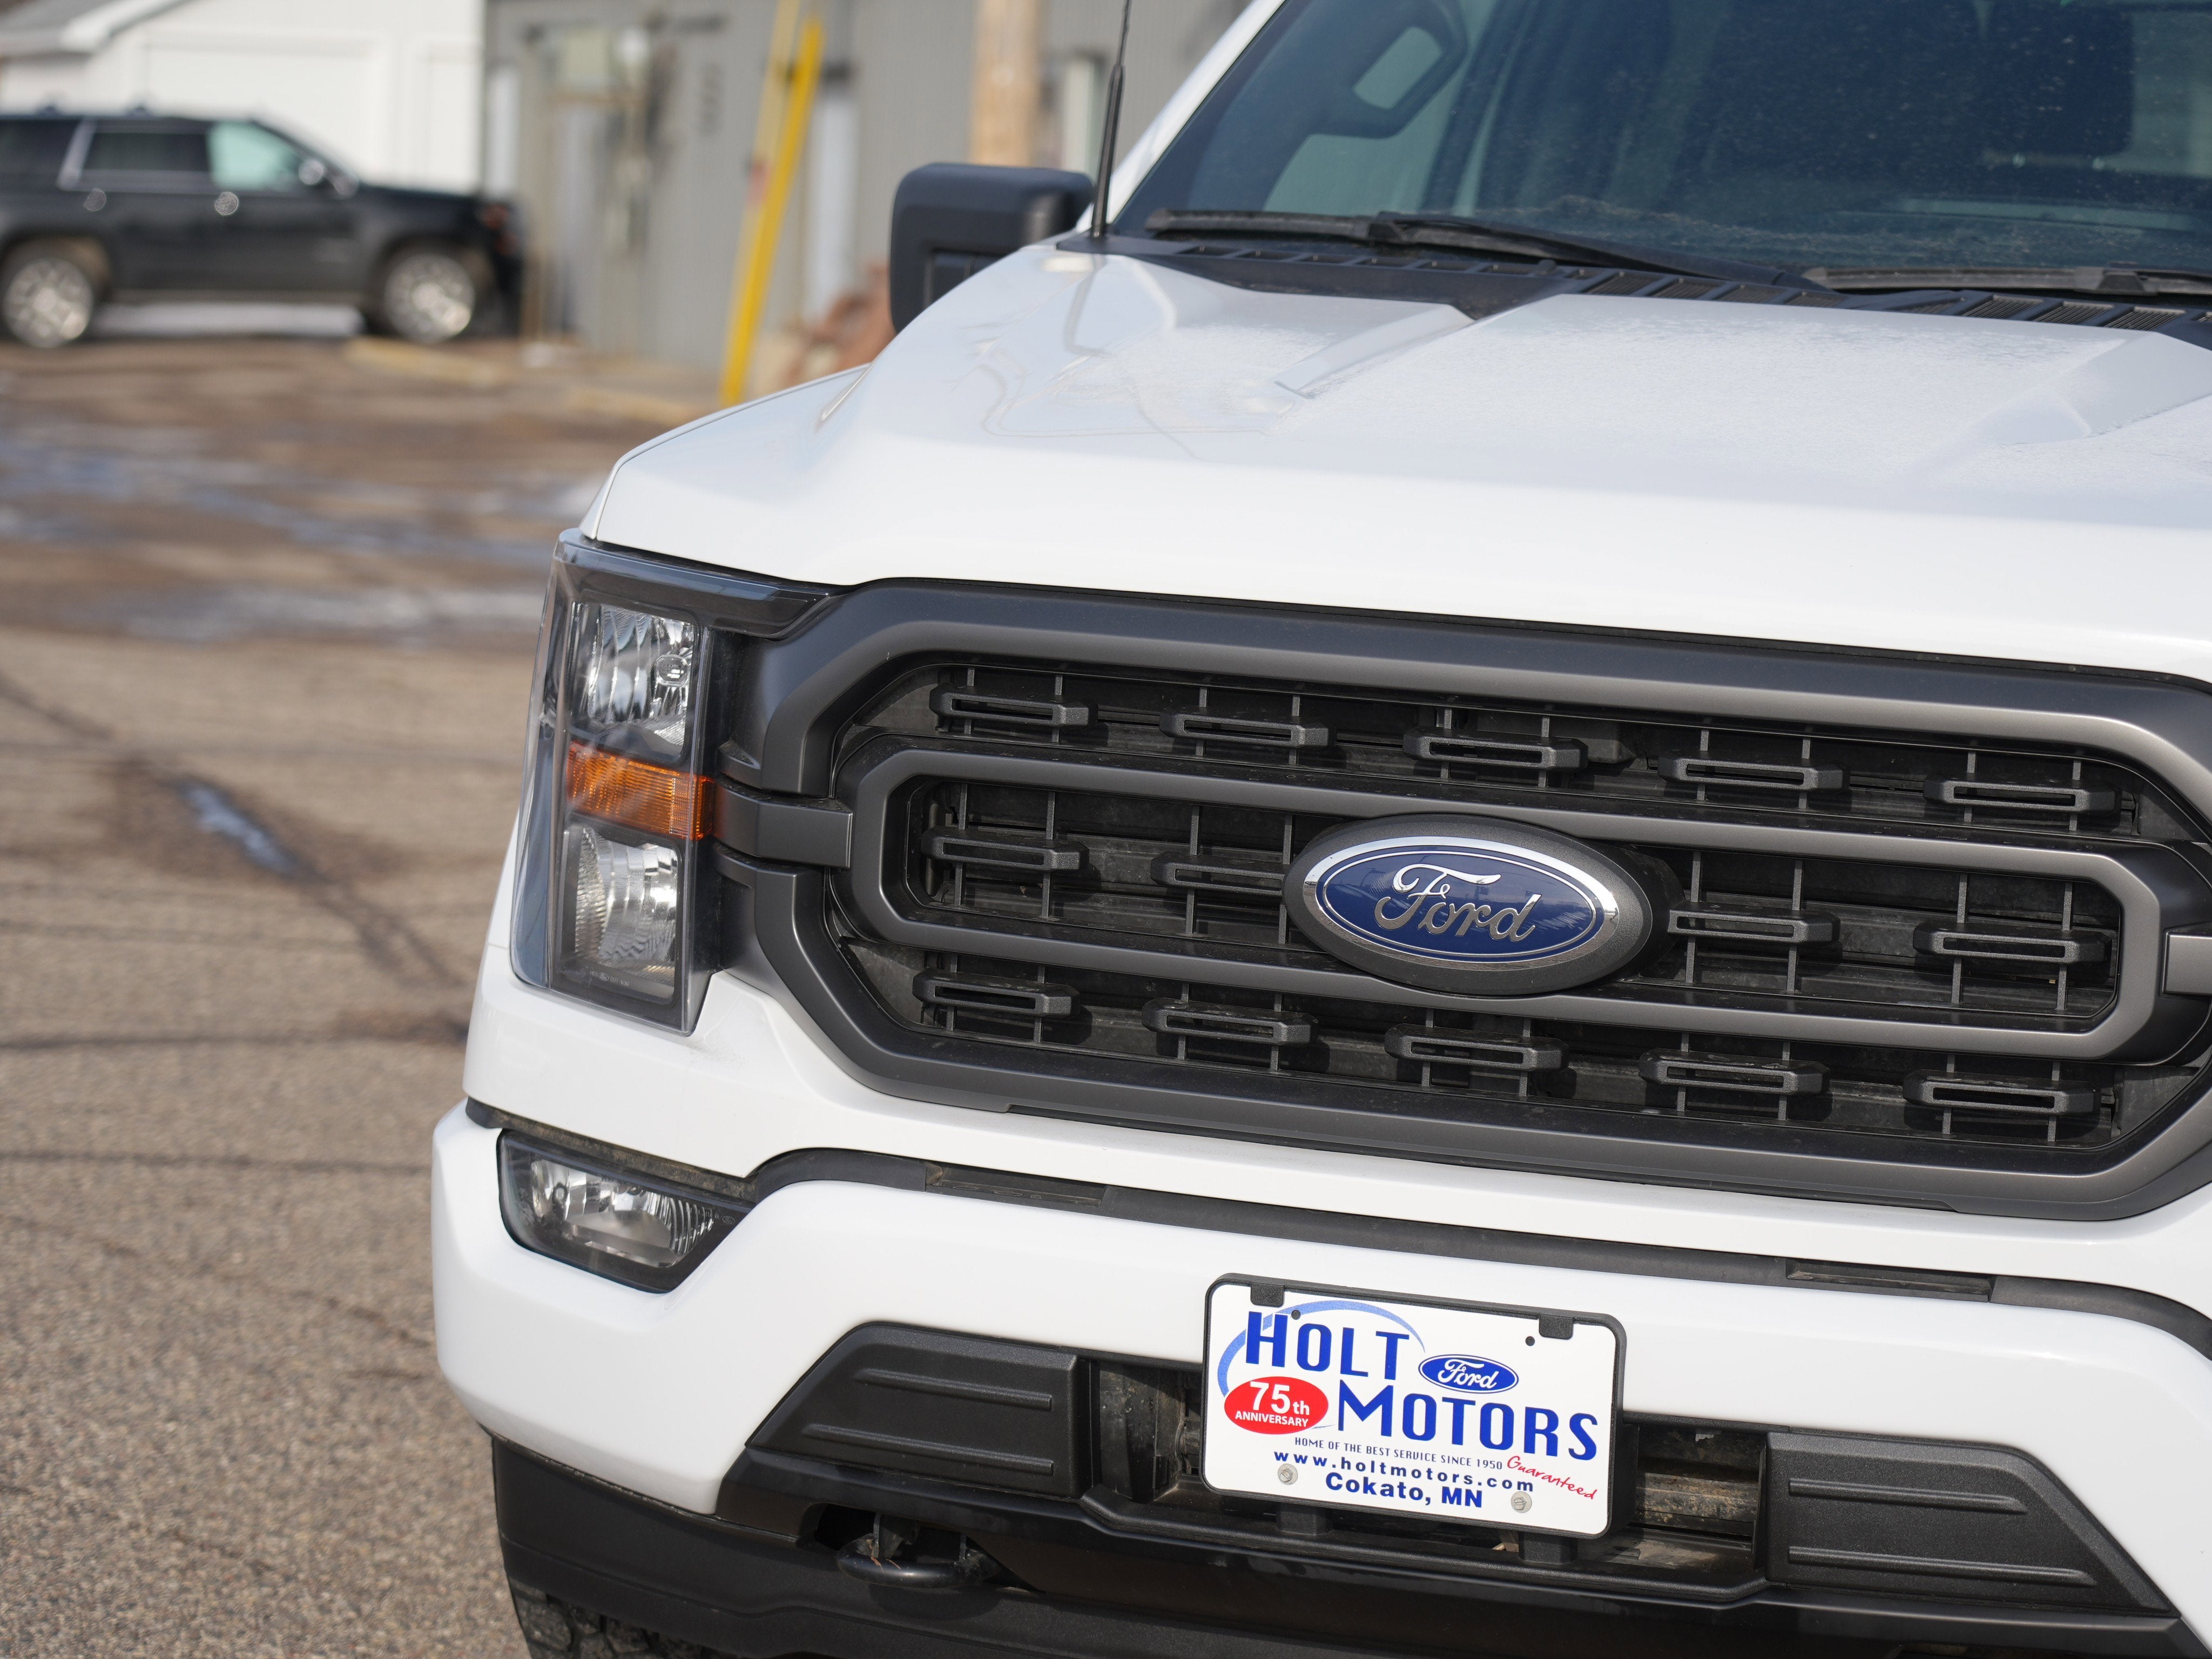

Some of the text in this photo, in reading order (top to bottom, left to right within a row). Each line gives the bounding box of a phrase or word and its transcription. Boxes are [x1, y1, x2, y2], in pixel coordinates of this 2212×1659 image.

[1374, 864, 1541, 942] Ford
[1246, 1311, 1410, 1380] HOLT
[1438, 1359, 1499, 1388] Ford
[1250, 1381, 1310, 1415] 75th
[1235, 1411, 1309, 1427] ANNIVERSARY
[1338, 1380, 1597, 1461] MOTORS
[1274, 1451, 1533, 1492] www.holtmotors.com
[1295, 1437, 1502, 1470] HOME OF THE BEST SERVICE SINCE 1950
[1326, 1472, 1482, 1508] Cokato, MN
[1507, 1455, 1598, 1500] Guaranteed
